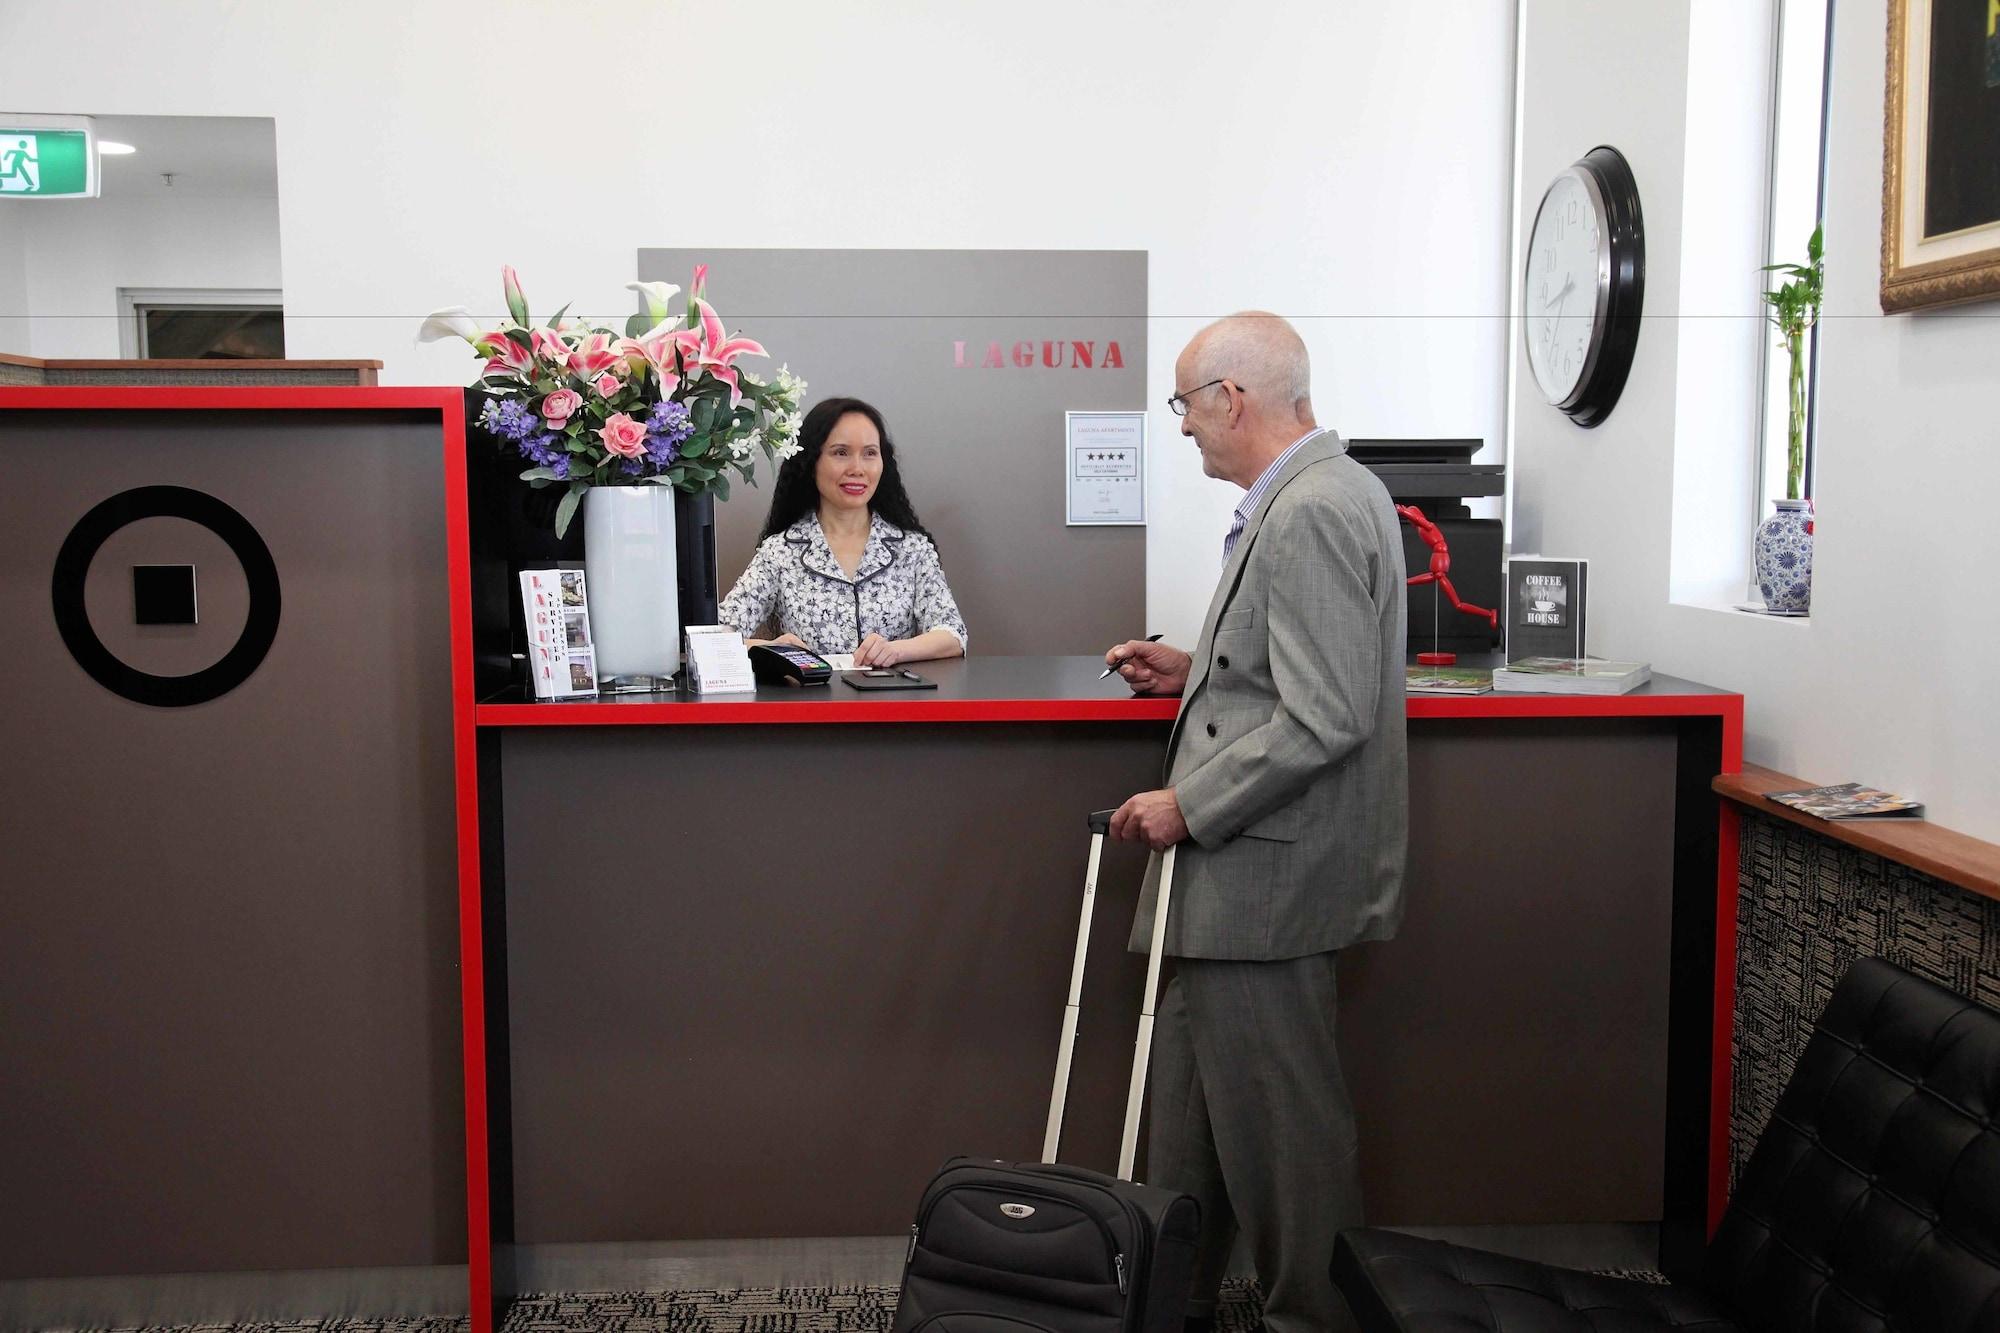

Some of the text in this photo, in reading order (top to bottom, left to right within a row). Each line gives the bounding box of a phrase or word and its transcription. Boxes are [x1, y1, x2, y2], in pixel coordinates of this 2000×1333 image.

[953, 340, 1125, 369] LAGUNA
[1526, 575, 1561, 586] COFFEE
[531, 576, 553, 680] LAGUNA
[547, 591, 561, 663] SERVICED
[556, 597, 566, 657] APARTMENTS
[1528, 613, 1560, 624] HOUSE
